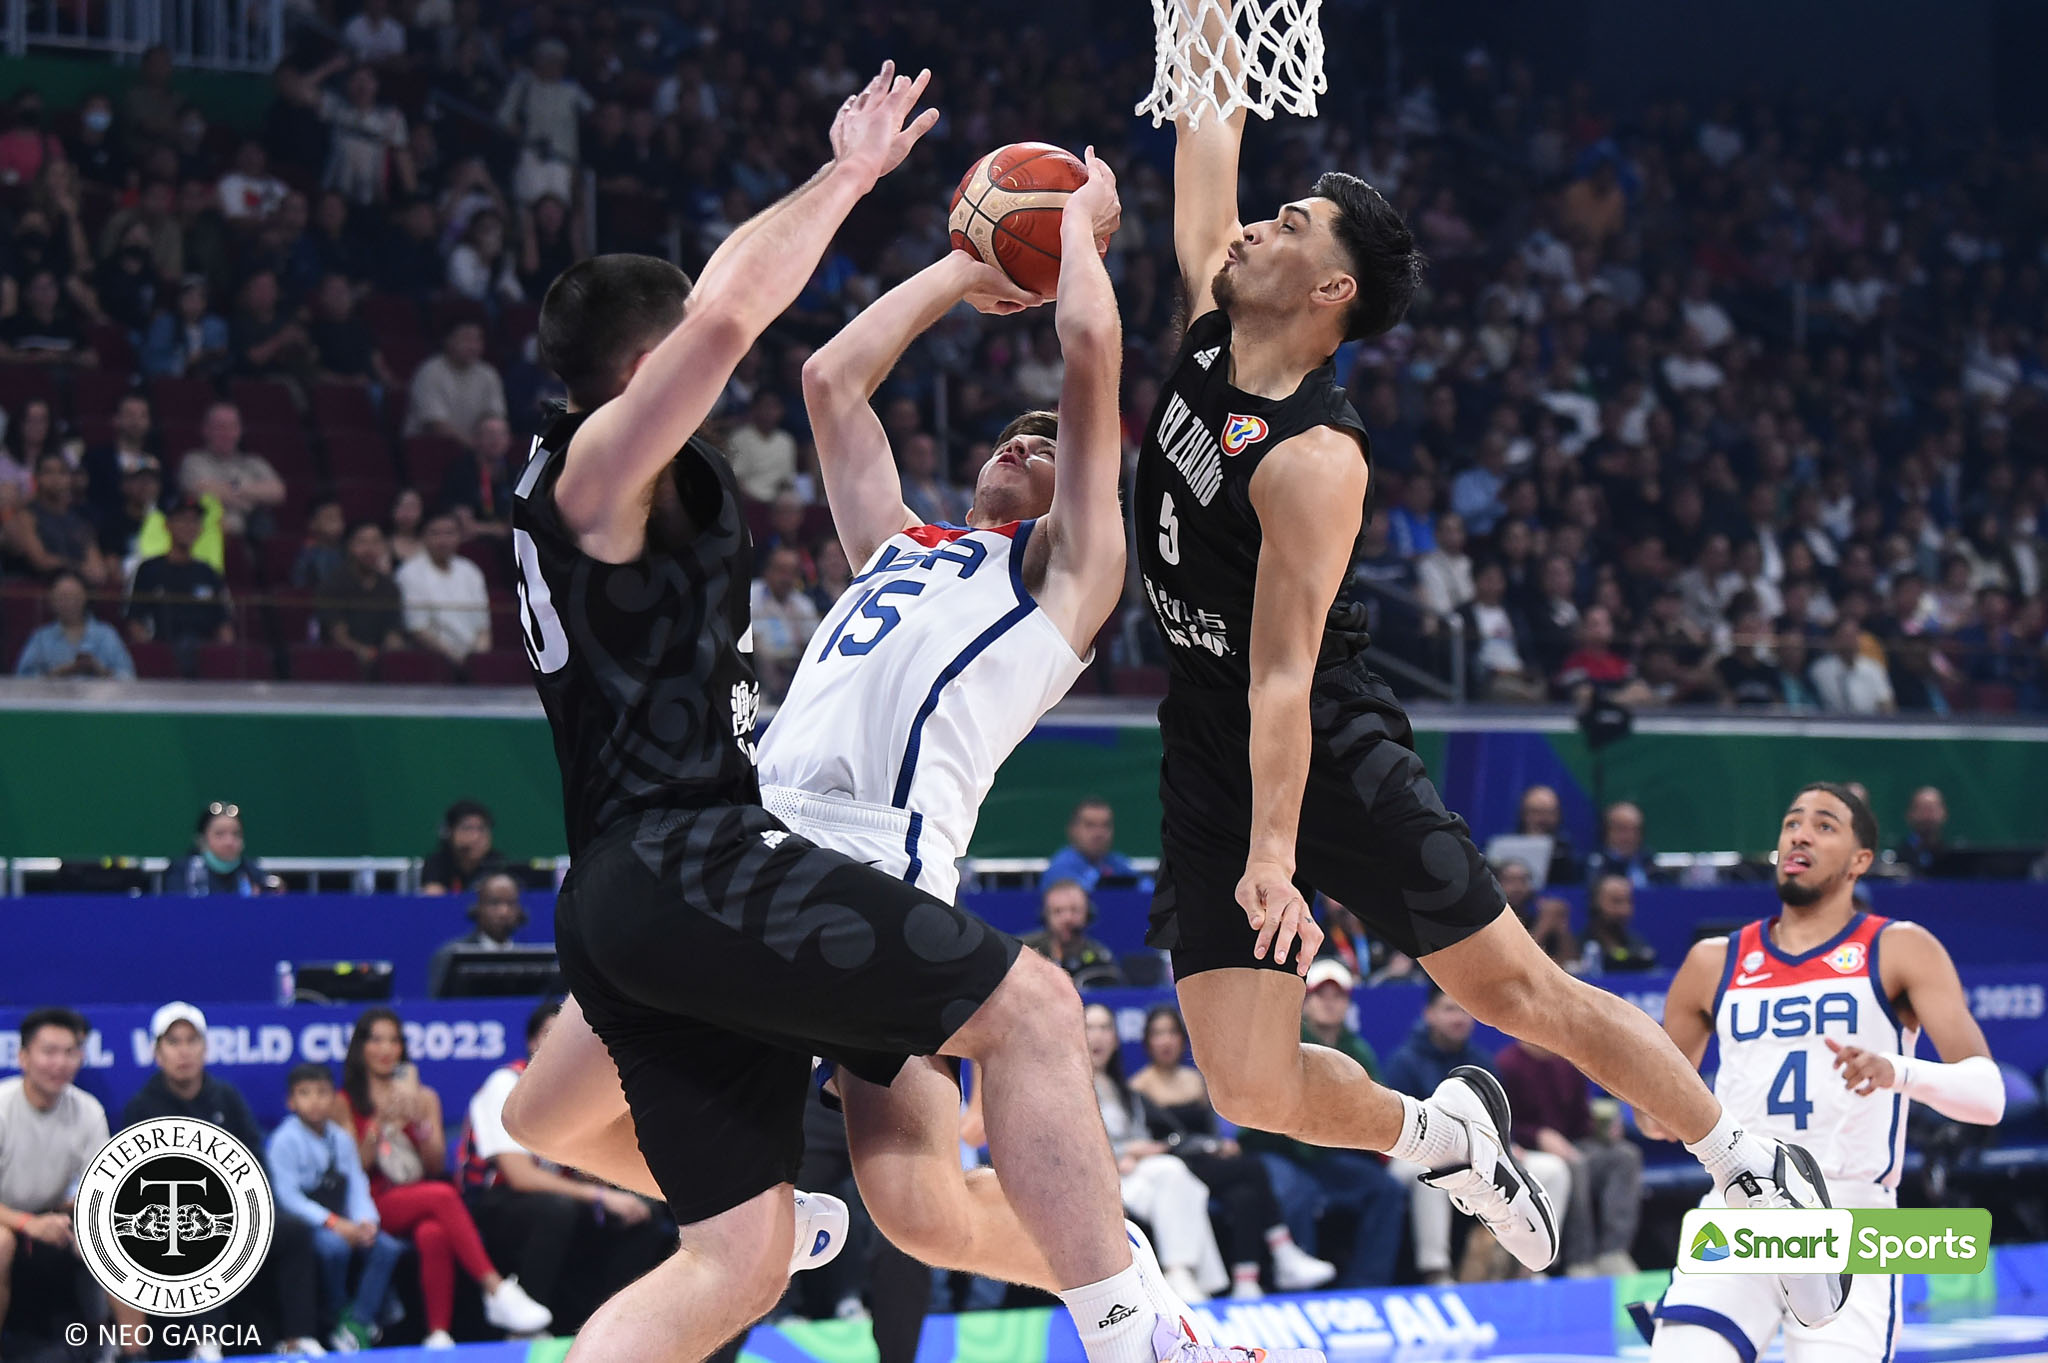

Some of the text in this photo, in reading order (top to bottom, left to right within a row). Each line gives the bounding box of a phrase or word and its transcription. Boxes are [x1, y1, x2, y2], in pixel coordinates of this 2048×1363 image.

[1157, 390, 1224, 507] NEW ZEALAND
[1159, 491, 1180, 566] 5
[851, 538, 988, 586] USA
[817, 579, 926, 664] 15
[131, 1026, 293, 1067] WRLD
[402, 1020, 506, 1060] 2023
[1731, 992, 1858, 1042] USA
[1767, 1050, 1814, 1131] 4
[1098, 1305, 1139, 1328] PEAK
[1193, 1302, 1326, 1351] WIN
[1382, 1293, 1498, 1348] ALL
